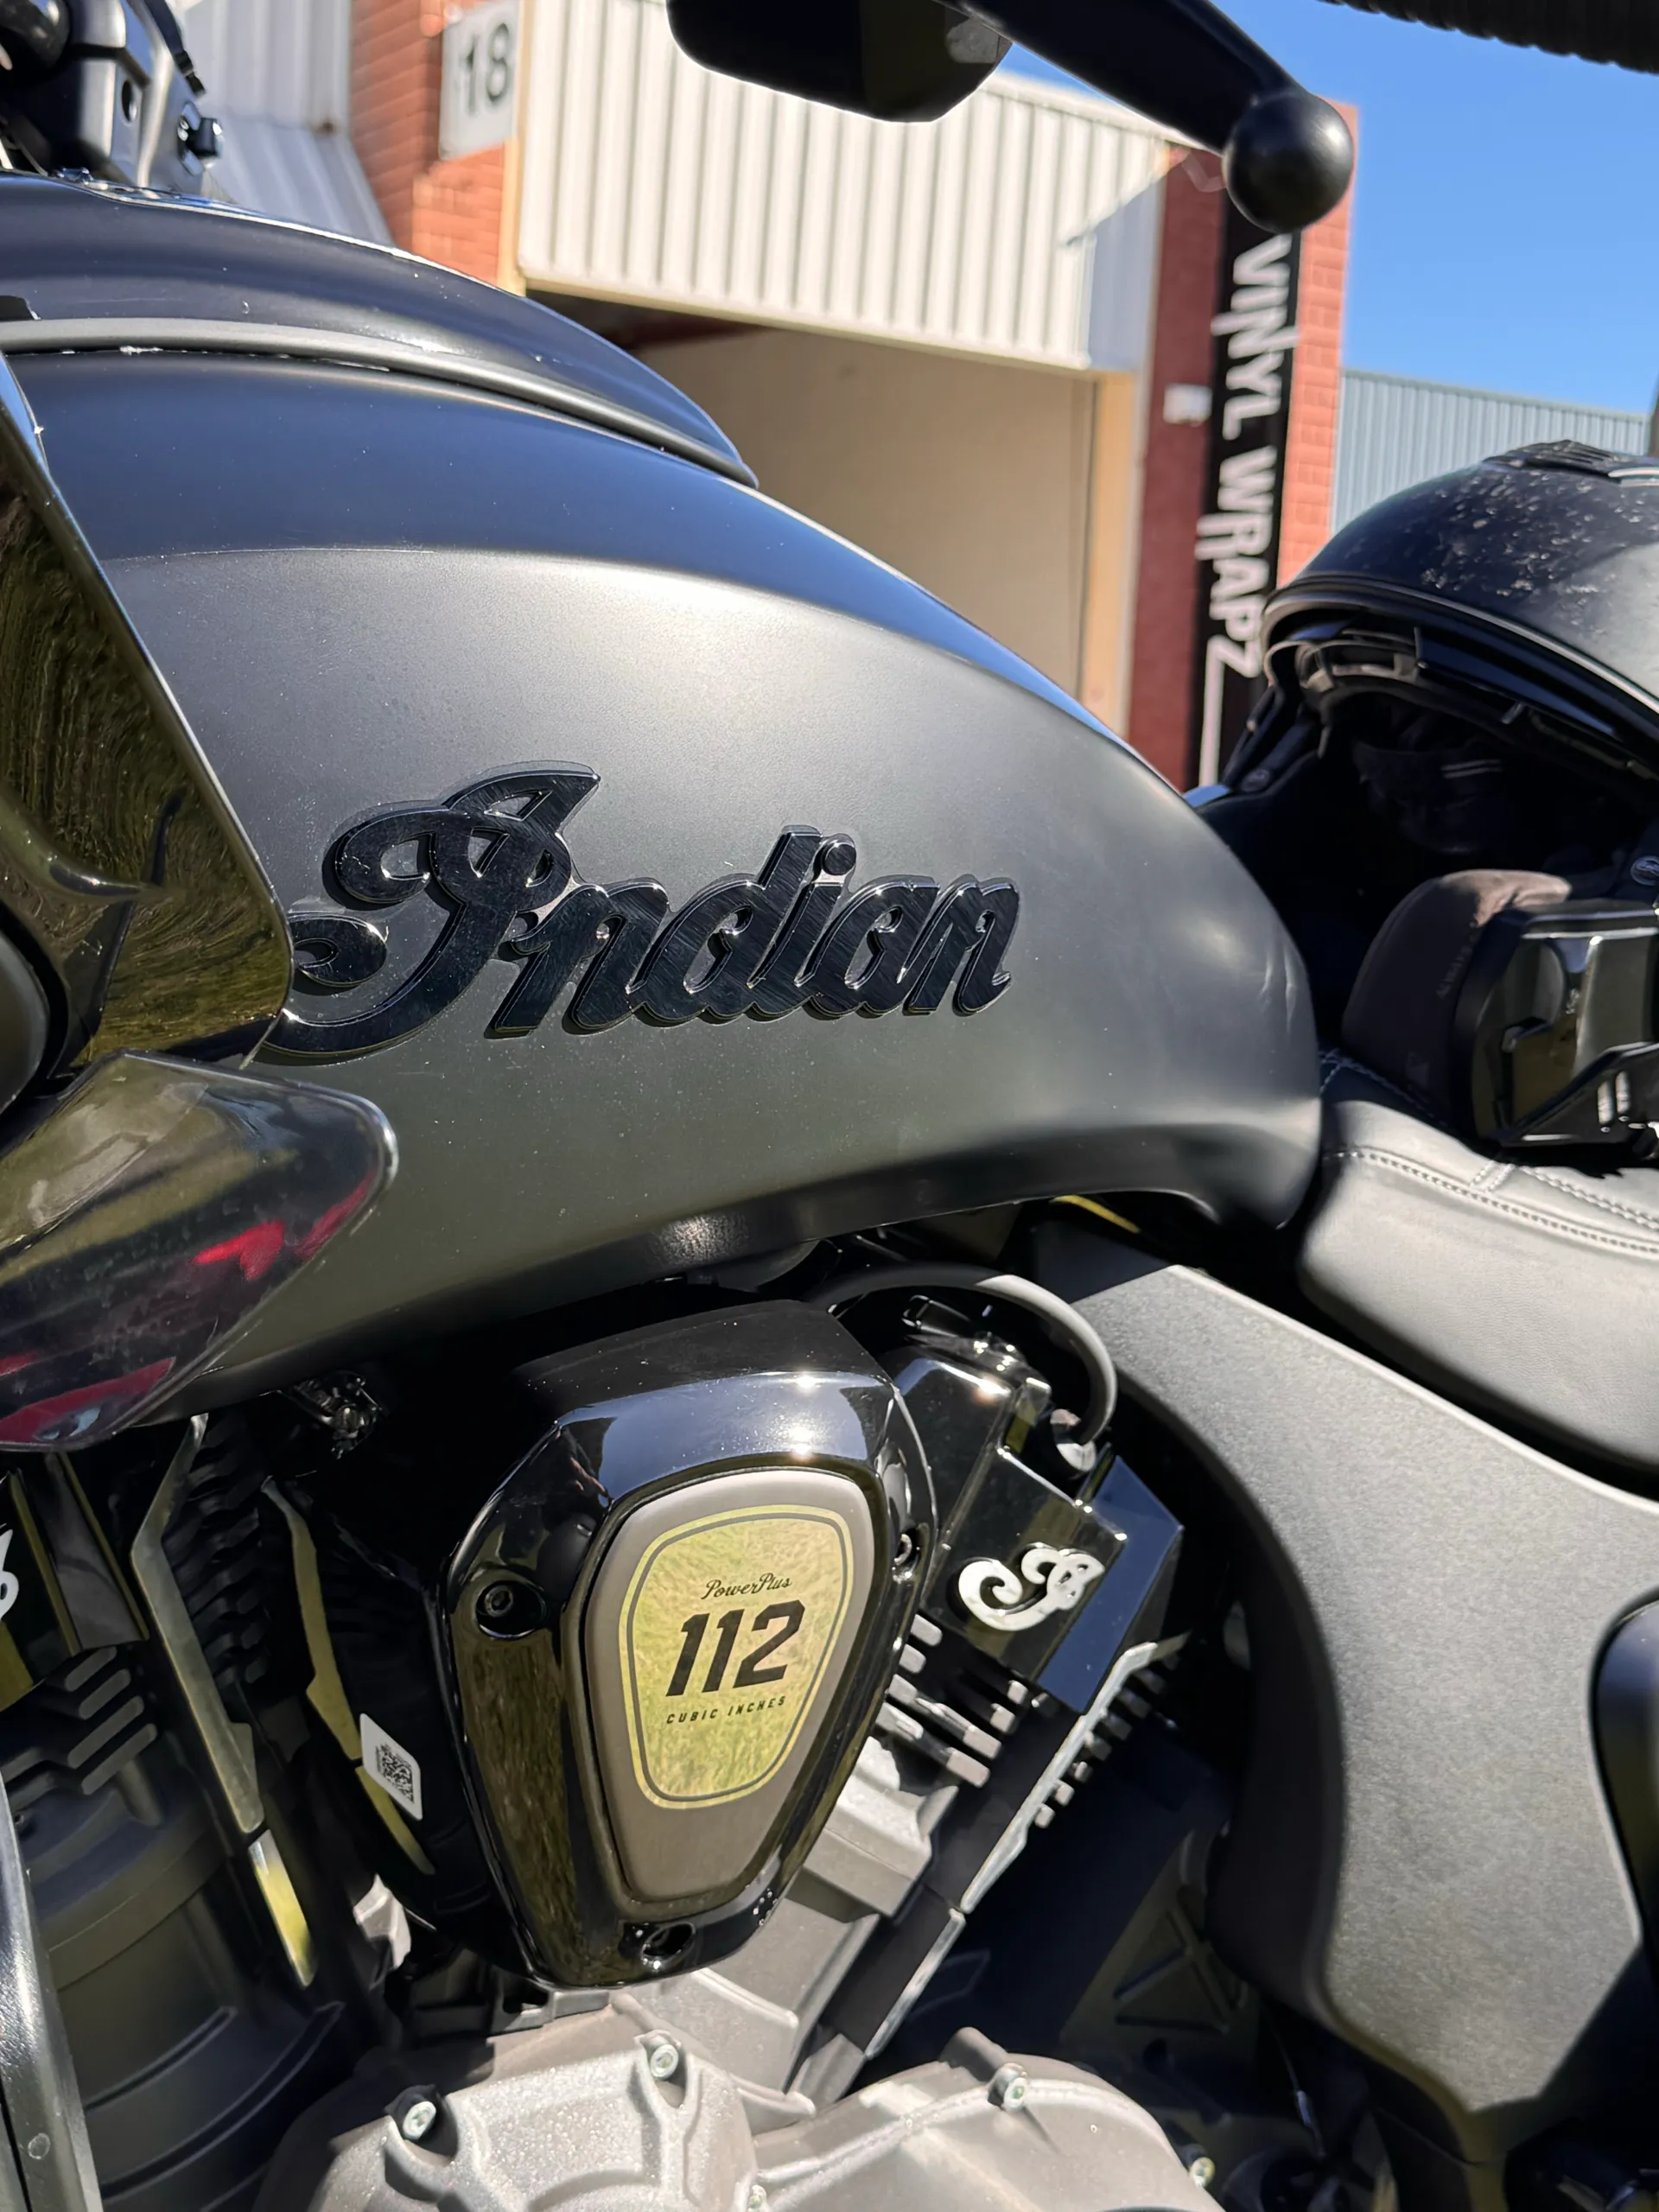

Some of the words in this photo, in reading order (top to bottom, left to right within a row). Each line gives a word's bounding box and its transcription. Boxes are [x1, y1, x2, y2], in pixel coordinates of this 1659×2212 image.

[459, 22, 511, 116] 18
[1211, 232, 1300, 441] VINYL
[1194, 444, 1277, 784] WRAPZ
[262, 762, 1020, 1057] Indian
[702, 1573, 791, 1599] PowerPlus
[665, 1599, 805, 1696] 112
[666, 1708, 718, 1725] CUBIC
[728, 1696, 785, 1716] INCHES
